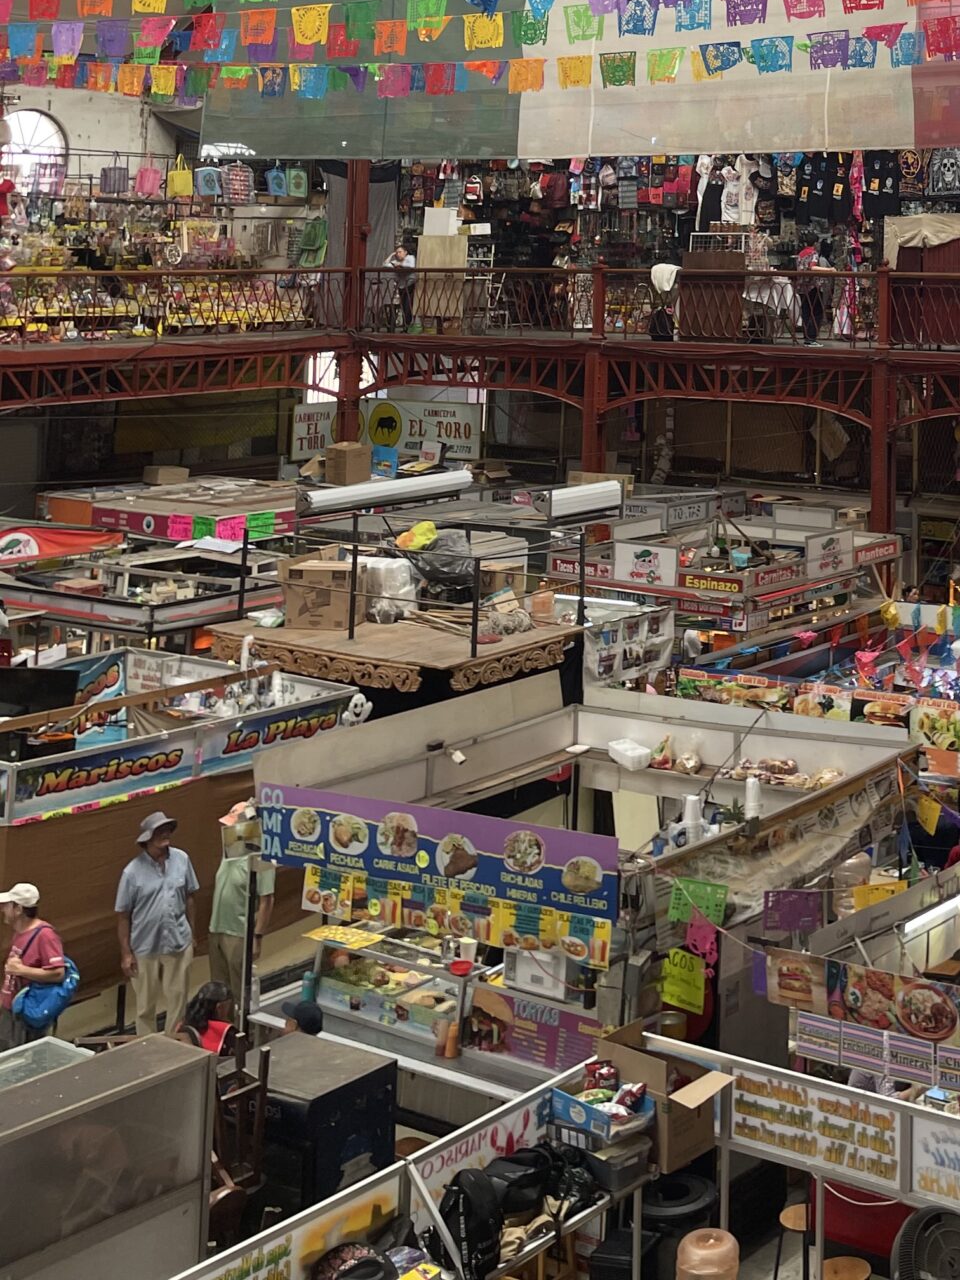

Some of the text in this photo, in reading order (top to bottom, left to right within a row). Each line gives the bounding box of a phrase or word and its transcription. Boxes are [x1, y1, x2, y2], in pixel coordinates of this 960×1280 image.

[306, 422, 320, 436] EL
[408, 419, 472, 440] EL TORO
[297, 434, 326, 452] TORO
[625, 504, 648, 515] PATITAS
[857, 544, 895, 563] Manteca
[556, 559, 573, 574] Tacos
[685, 575, 739, 593] Espinazo
[757, 568, 793, 586] Carnitas
[37, 710, 339, 796] Mariscos La Playa
[261, 787, 284, 809] CO
[263, 810, 283, 833] MI
[262, 835, 283, 858] DA
[329, 852, 365, 869] PECHUGA
[373, 858, 397, 872] CARNE
[397, 861, 420, 875] ASADA
[421, 873, 447, 888] FILETE
[459, 879, 497, 897] PESCADO
[500, 873, 544, 889] ENCHILADAS
[506, 887, 538, 903] MINERAS
[551, 891, 608, 911] CHILE RELLENO
[513, 998, 560, 1026] TORTAS
[890, 1050, 931, 1070] Mineras
